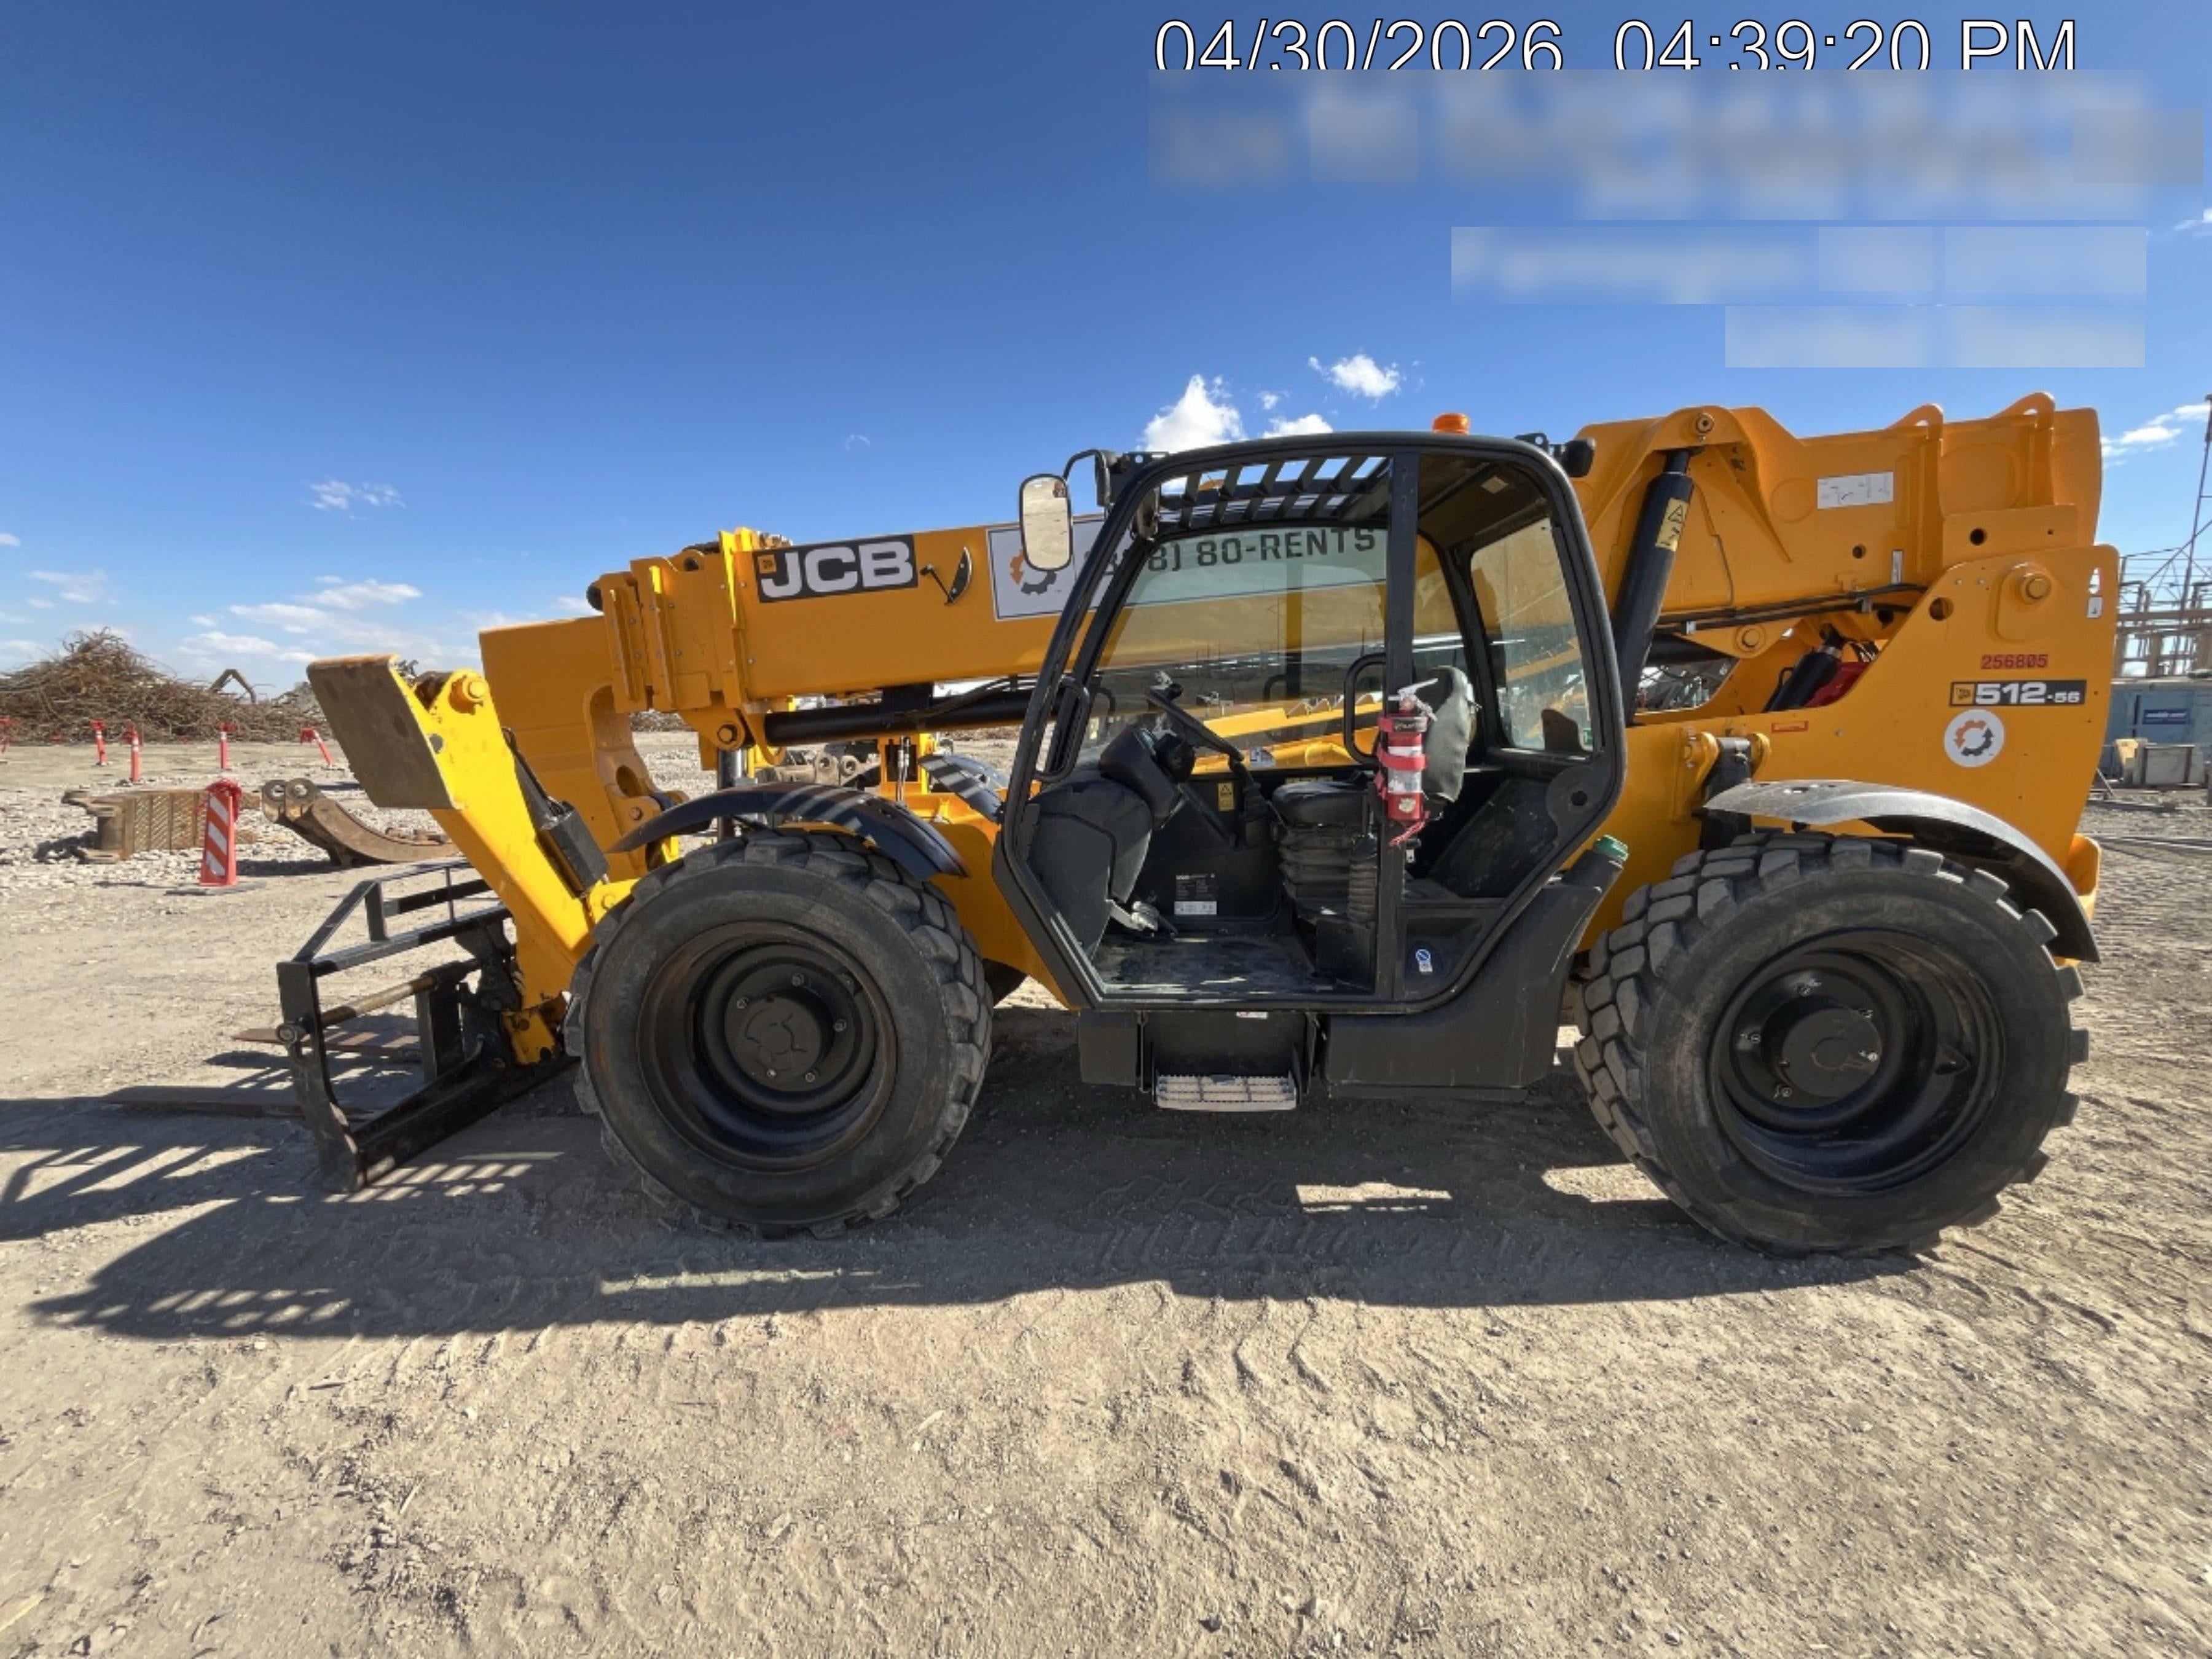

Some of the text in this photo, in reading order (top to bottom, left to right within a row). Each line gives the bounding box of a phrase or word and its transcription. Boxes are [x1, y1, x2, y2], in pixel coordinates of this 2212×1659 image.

[1196, 528, 1376, 567] 80-RENTS
[760, 541, 914, 598] JCB
[1980, 654, 2049, 670] 256805
